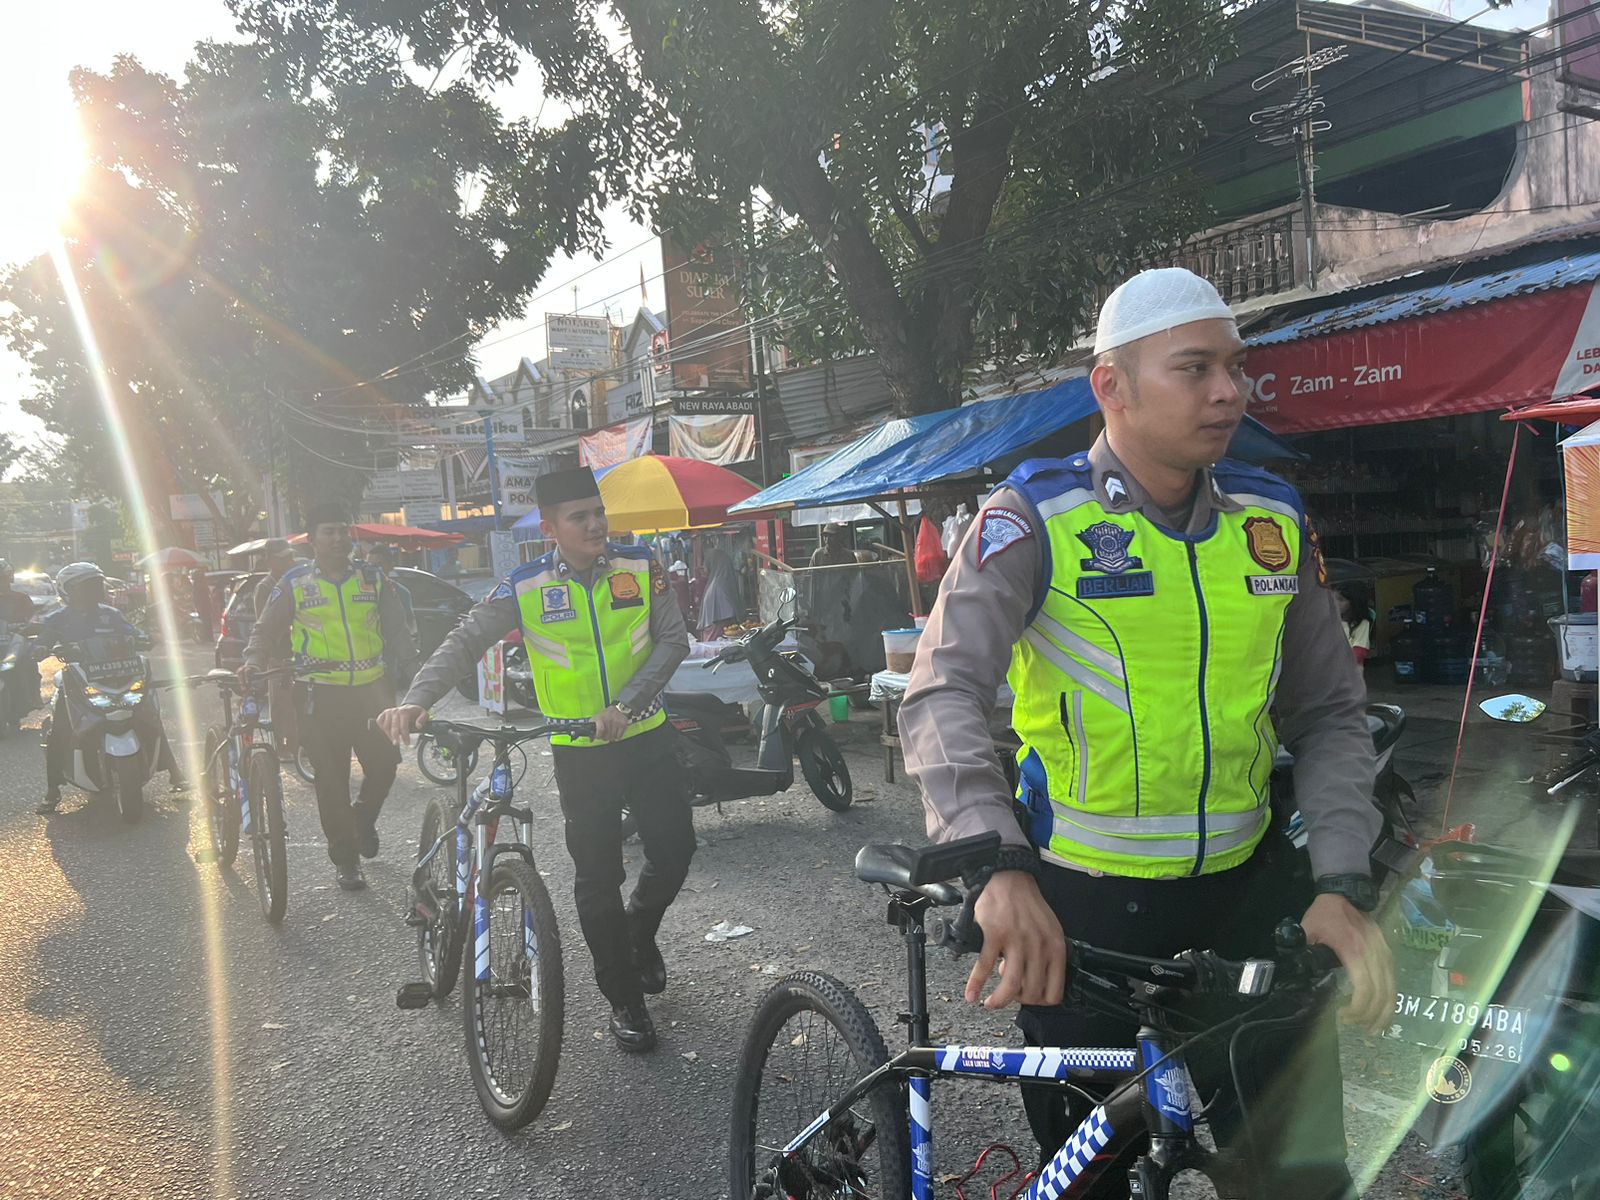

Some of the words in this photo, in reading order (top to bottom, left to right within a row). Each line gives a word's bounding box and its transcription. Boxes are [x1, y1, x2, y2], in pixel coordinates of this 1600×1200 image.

[687, 285, 726, 300] SUER
[1290, 375, 1334, 396] Zam
[1353, 363, 1402, 387] Zam
[679, 401, 700, 411] NEW
[701, 401, 725, 411] RAYA
[726, 401, 753, 411] ABADI
[1422, 999, 1480, 1027] 4189
[1481, 1007, 1523, 1035] ABA
